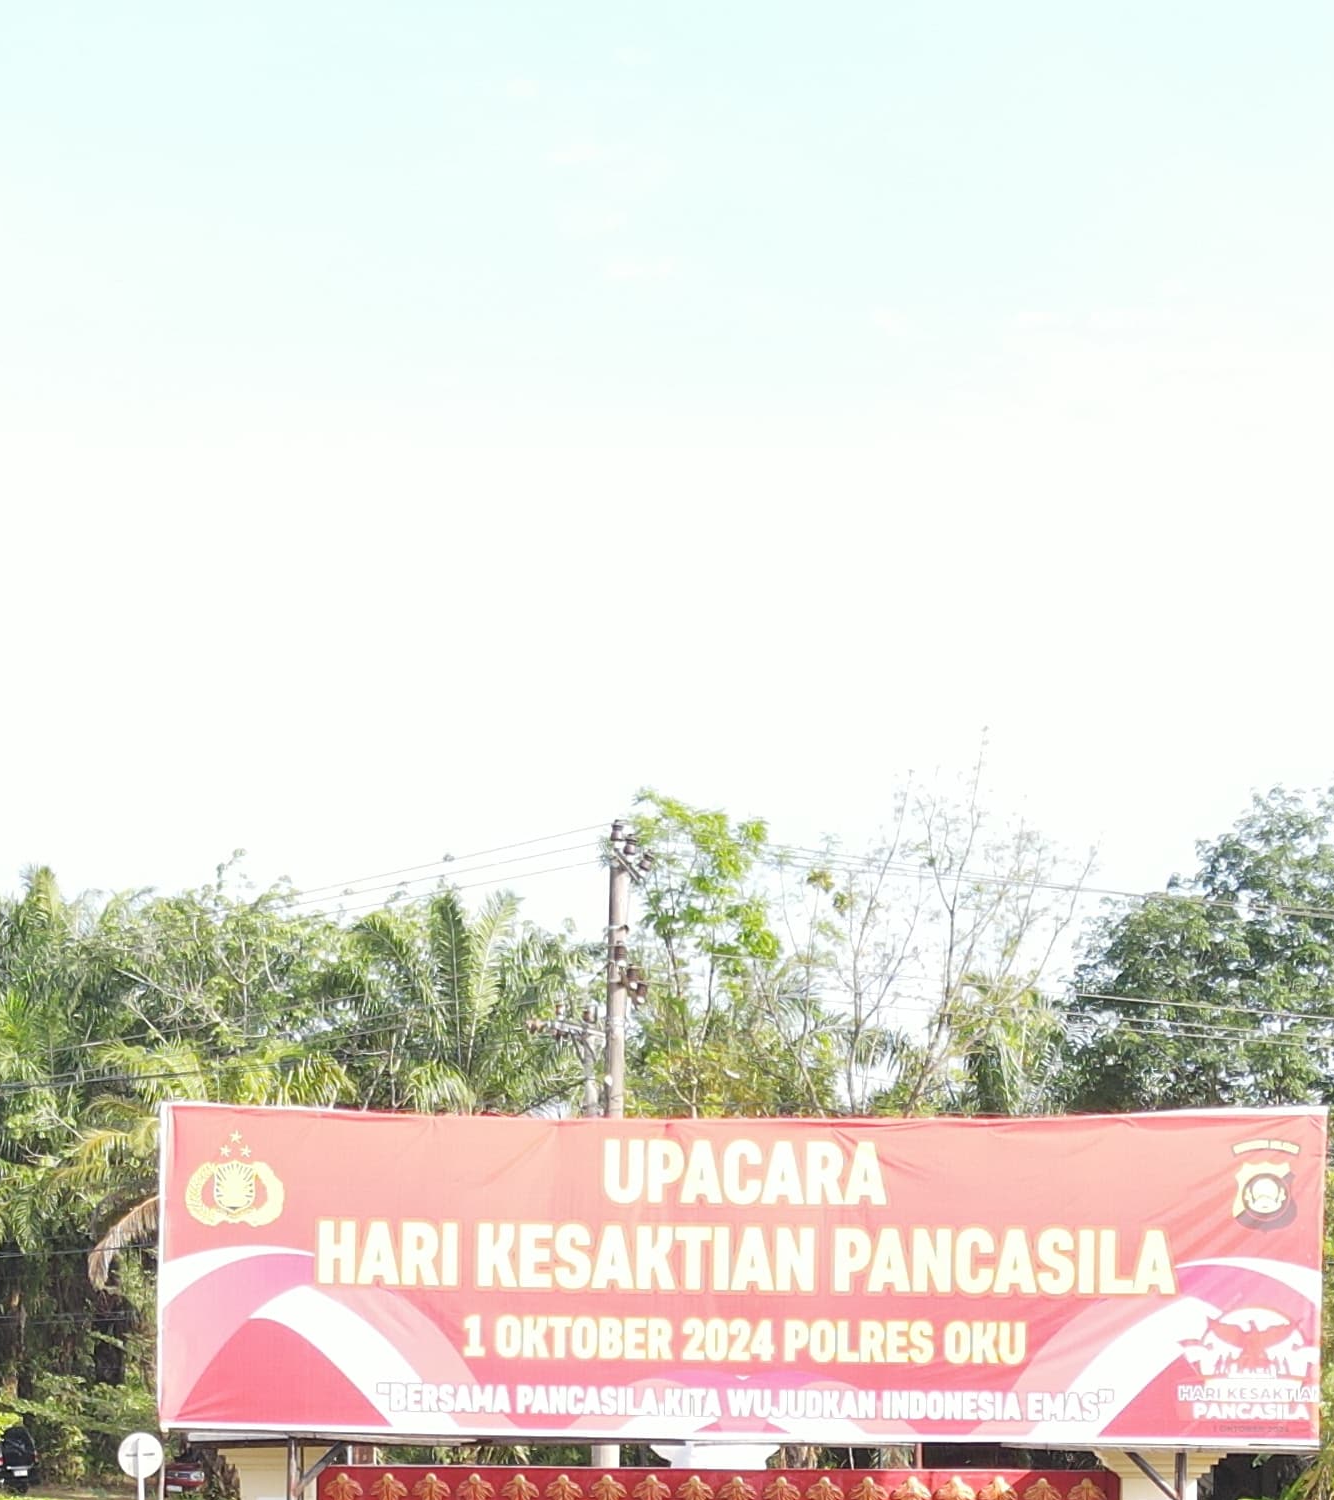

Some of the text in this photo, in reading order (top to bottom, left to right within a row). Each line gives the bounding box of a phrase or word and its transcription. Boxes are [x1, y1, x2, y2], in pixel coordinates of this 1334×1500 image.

[603, 1138, 888, 1205] UPACARA
[316, 1219, 1178, 1295] HARI KESAKTIAN PANCASILA
[463, 1314, 1027, 1365] 1 OKTOBER 2024 POLRES OKU
[517, 1385, 660, 1417] PANCASILA
[665, 1387, 721, 1418] KITA
[727, 1388, 875, 1420] WUJUDKAN
[882, 1389, 1021, 1421] INDONESIA
[1179, 1386, 1221, 1400] HARI
[1193, 1403, 1310, 1420] PANCASILA
